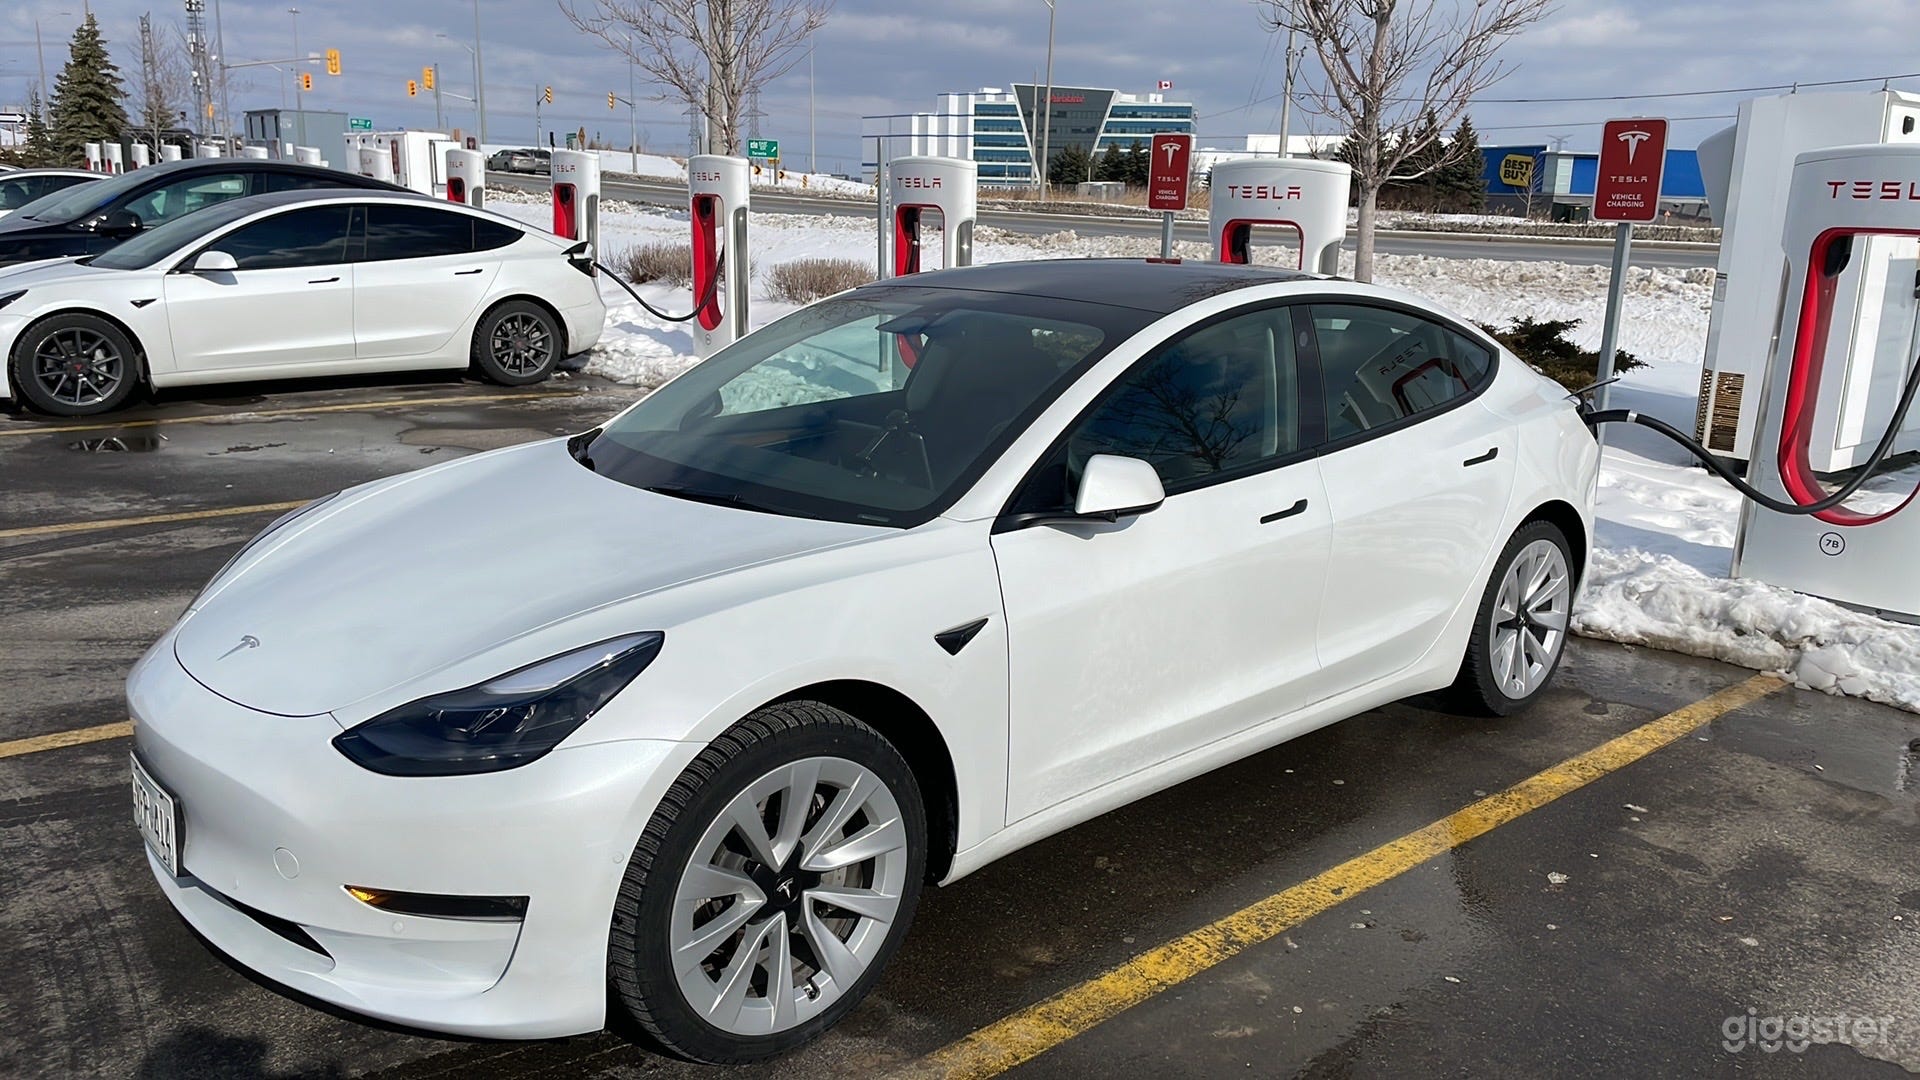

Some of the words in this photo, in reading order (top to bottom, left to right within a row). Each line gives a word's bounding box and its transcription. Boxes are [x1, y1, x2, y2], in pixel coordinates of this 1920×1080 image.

[1505, 159, 1531, 170] BEST
[692, 172, 720, 181] TESLA
[1504, 170, 1526, 181] BUY
[897, 177, 941, 188] TESLA
[1228, 185, 1301, 199] TESLA
[1826, 539, 1839, 548] 7B
